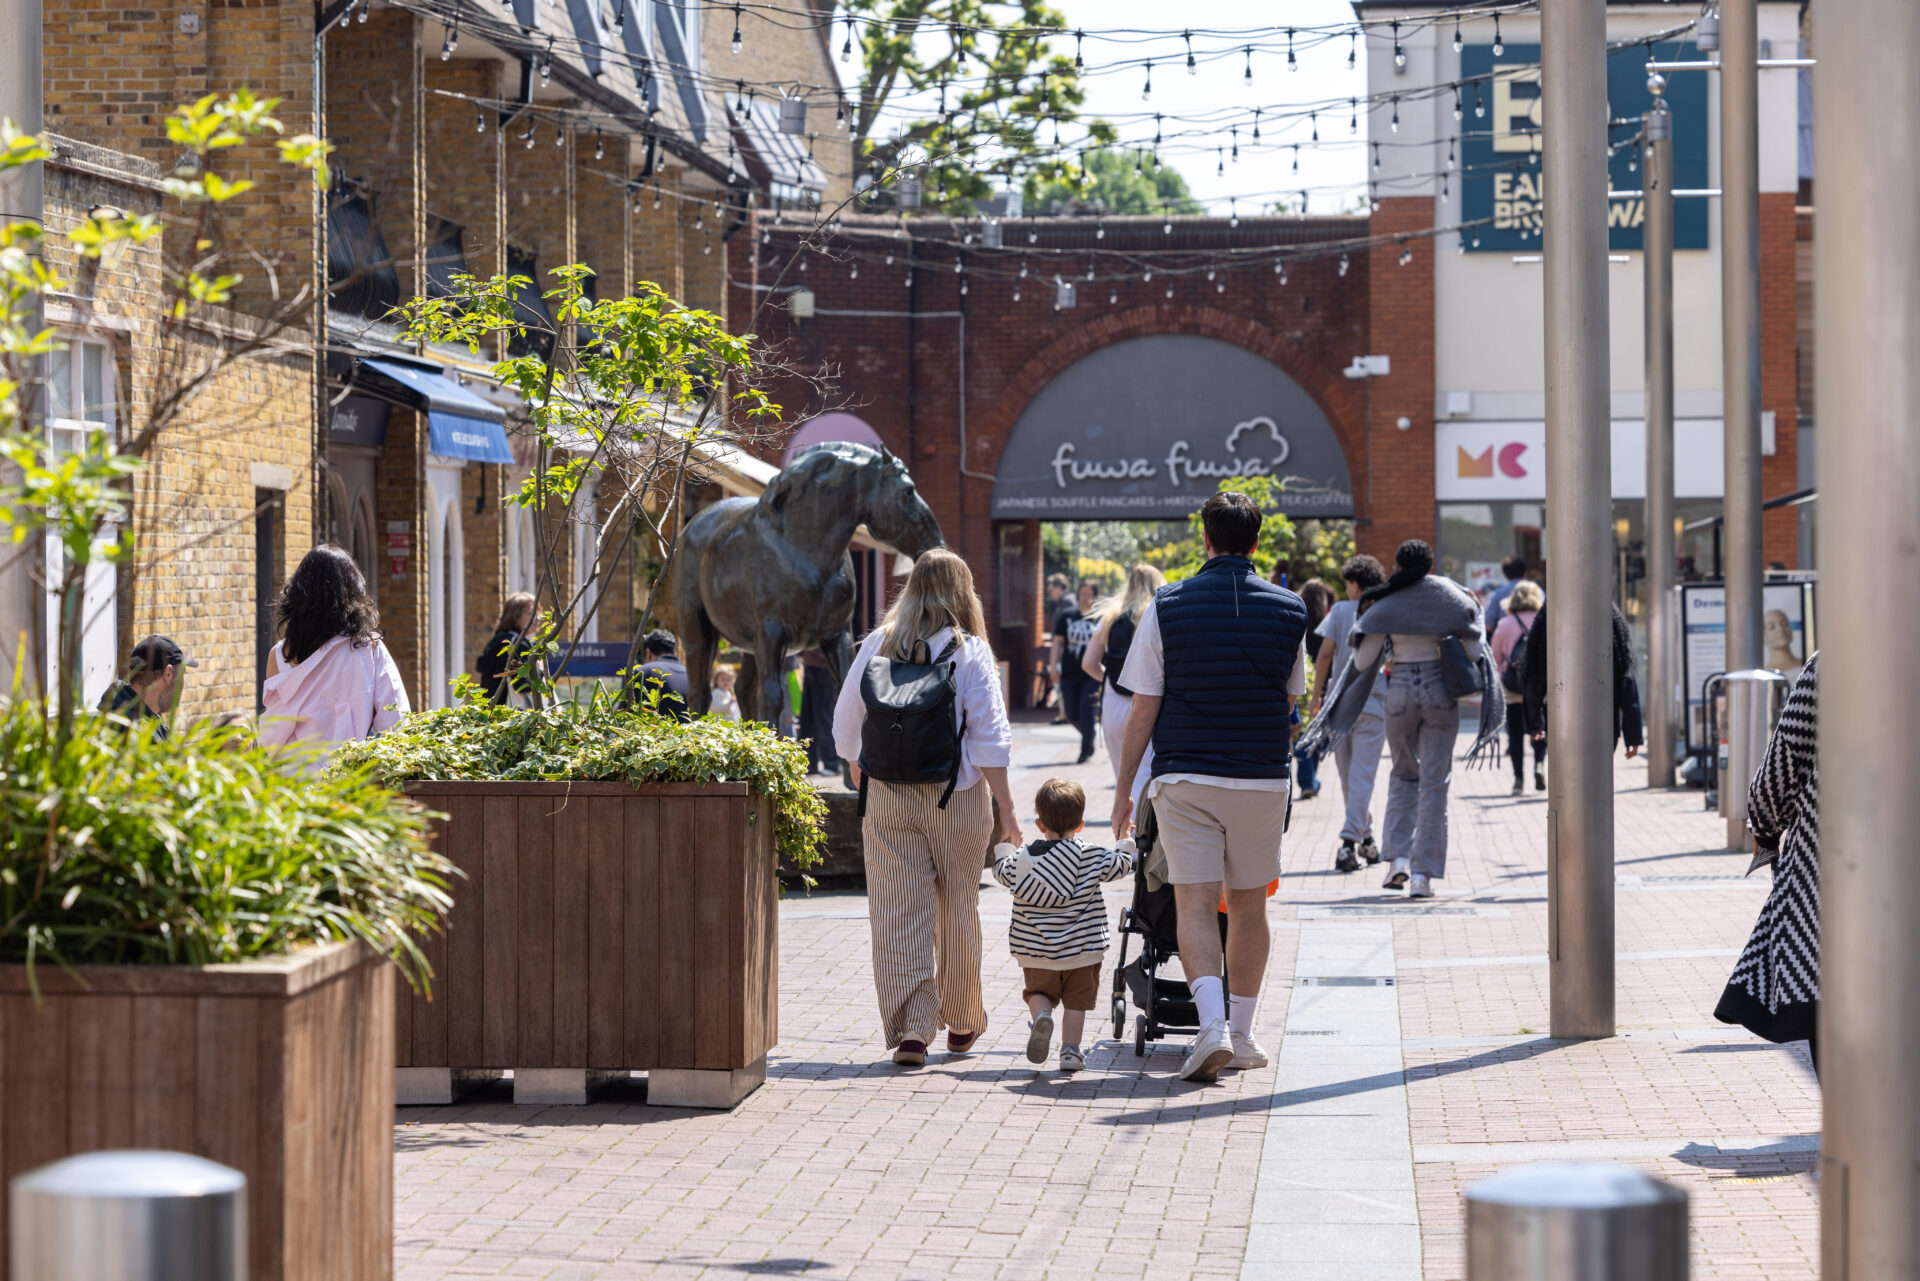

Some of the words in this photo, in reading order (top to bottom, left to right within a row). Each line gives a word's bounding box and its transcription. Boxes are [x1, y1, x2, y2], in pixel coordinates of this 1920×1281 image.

[1052, 442, 1156, 488] fuwa
[1165, 440, 1270, 486] fuwa
[1457, 442, 1528, 479] MC
[997, 496, 1048, 508] JAPANESE
[1099, 496, 1155, 507] PANCAKES
